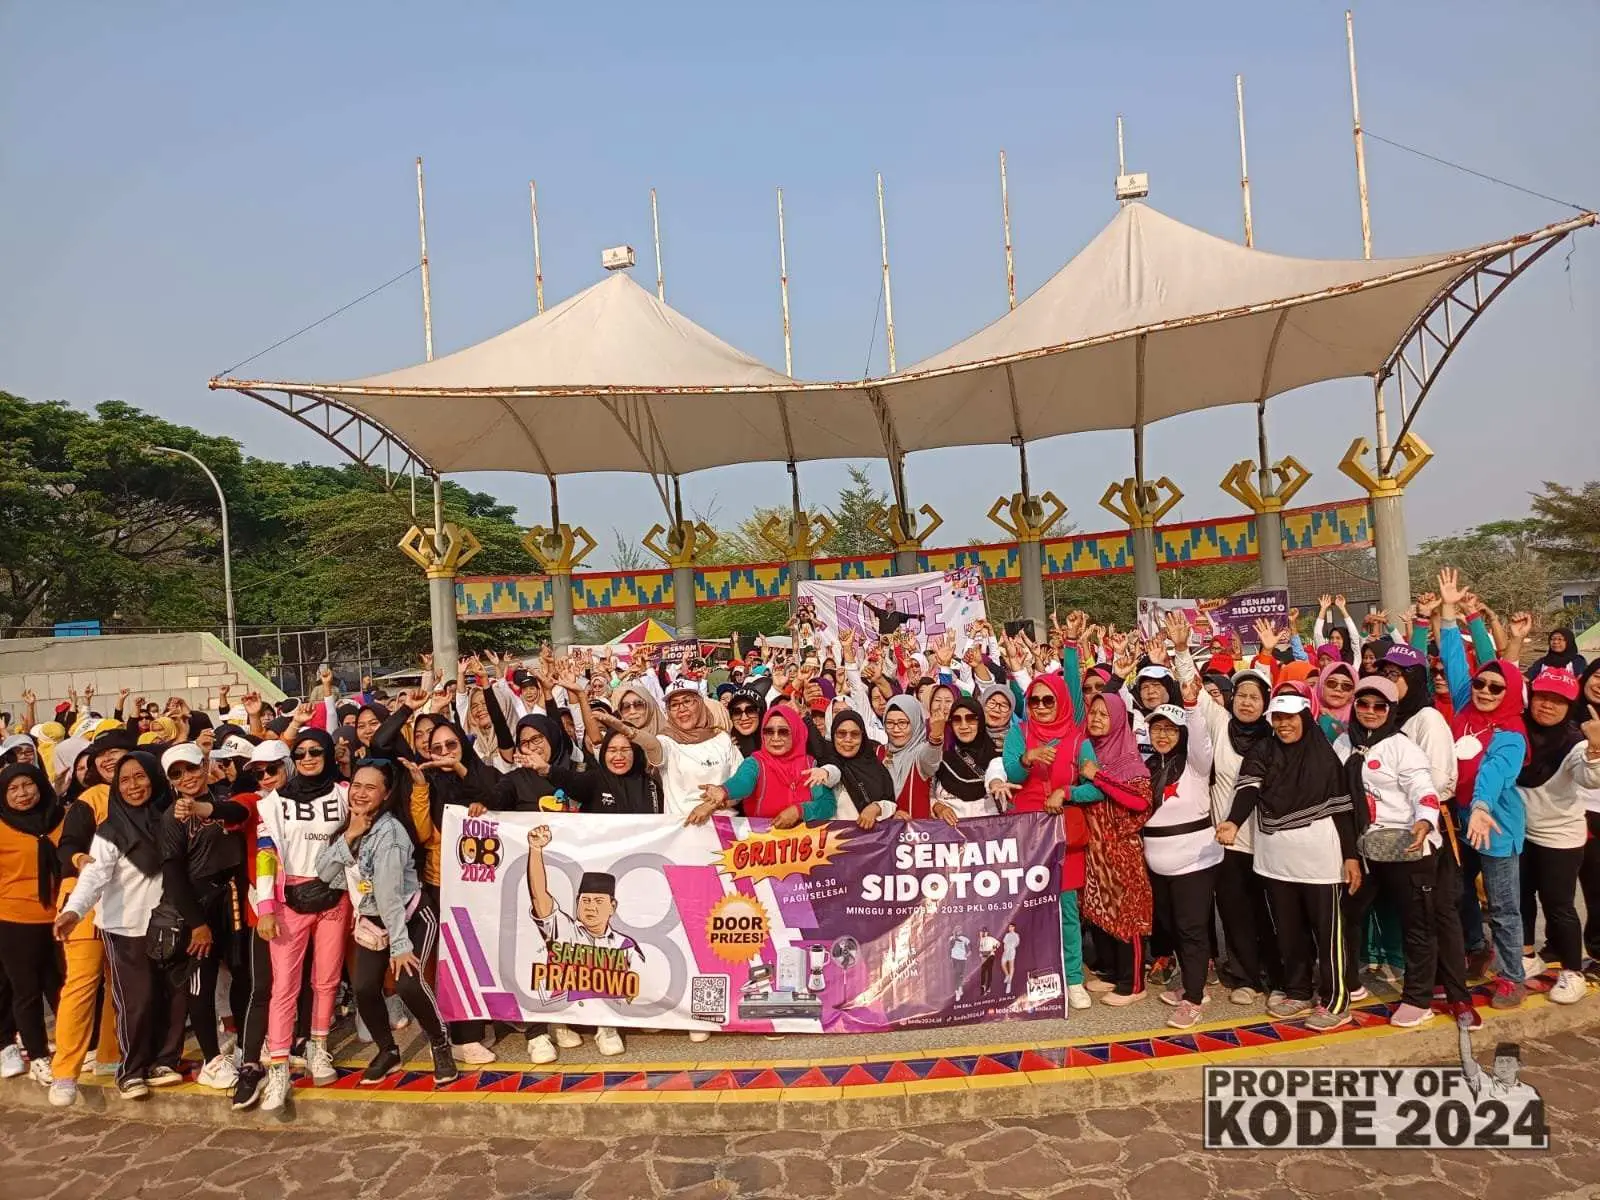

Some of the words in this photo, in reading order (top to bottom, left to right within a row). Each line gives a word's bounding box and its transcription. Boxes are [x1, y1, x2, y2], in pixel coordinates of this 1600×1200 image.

[1231, 604, 1285, 614] SIDOTOTO
[1240, 596, 1276, 606] SENAM
[462, 818, 500, 838] KODE
[895, 838, 1018, 870] SENAM
[461, 863, 496, 882] 2024
[793, 881, 813, 892] JAM
[815, 878, 836, 888] 6.30
[861, 865, 1051, 902] SIDOTOTO
[783, 887, 848, 904] PAGI/SELESAI
[846, 906, 884, 916] MINGGU
[887, 907, 893, 915] 8
[941, 904, 964, 914] 2023
[966, 903, 984, 913] PKL
[987, 901, 1013, 911] 06.30
[1023, 895, 1057, 908] SELESAI
[712, 917, 763, 931] DOOR
[710, 932, 764, 944] PRIZES!
[532, 962, 640, 998] PRABOWO
